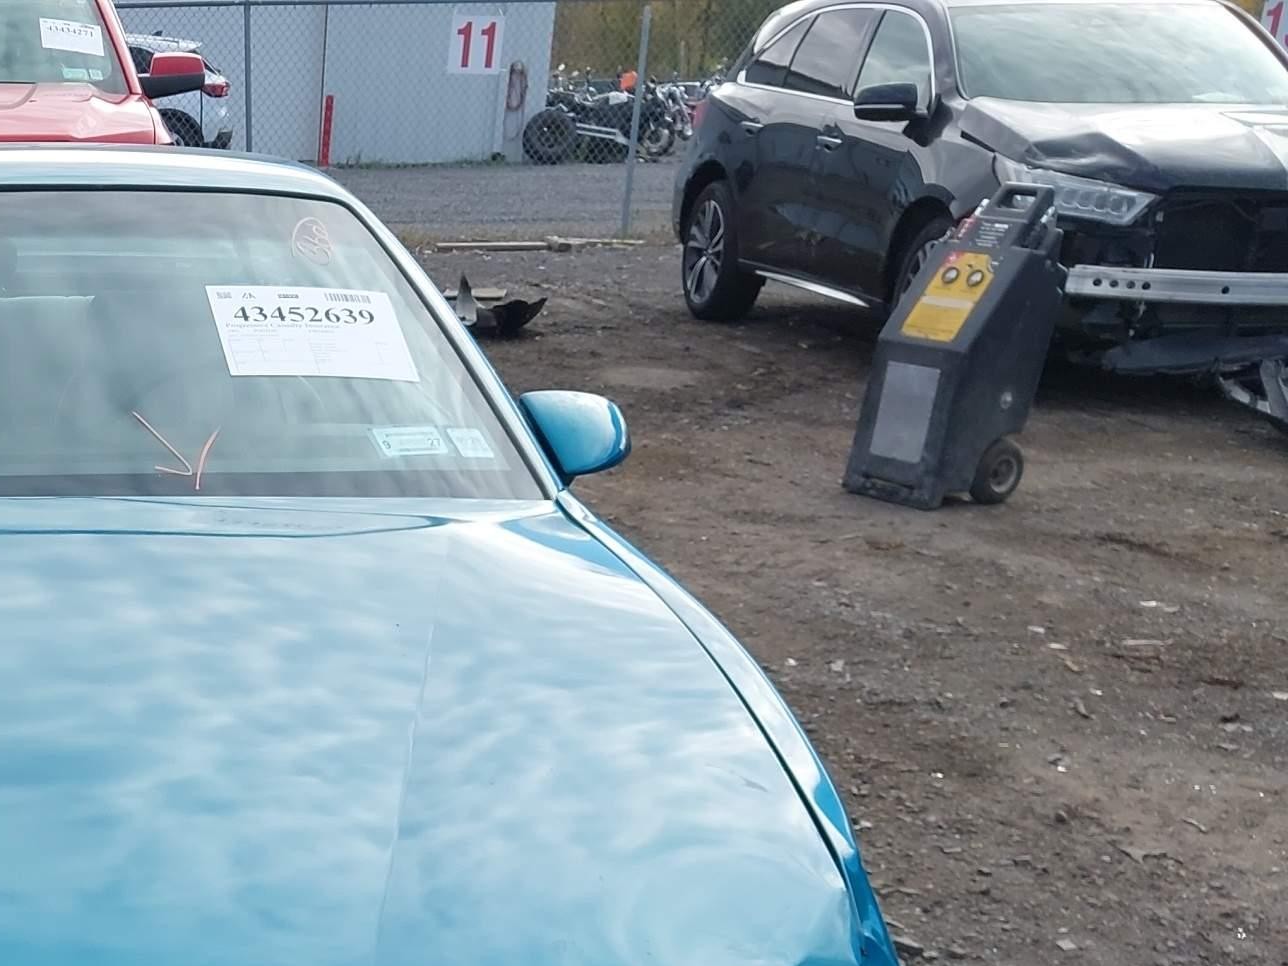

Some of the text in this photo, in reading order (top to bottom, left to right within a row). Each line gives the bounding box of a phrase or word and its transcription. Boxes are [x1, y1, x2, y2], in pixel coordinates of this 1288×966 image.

[457, 21, 497, 69] 11
[1267, 1, 1288, 47] 1
[233, 306, 374, 325] 43452639
